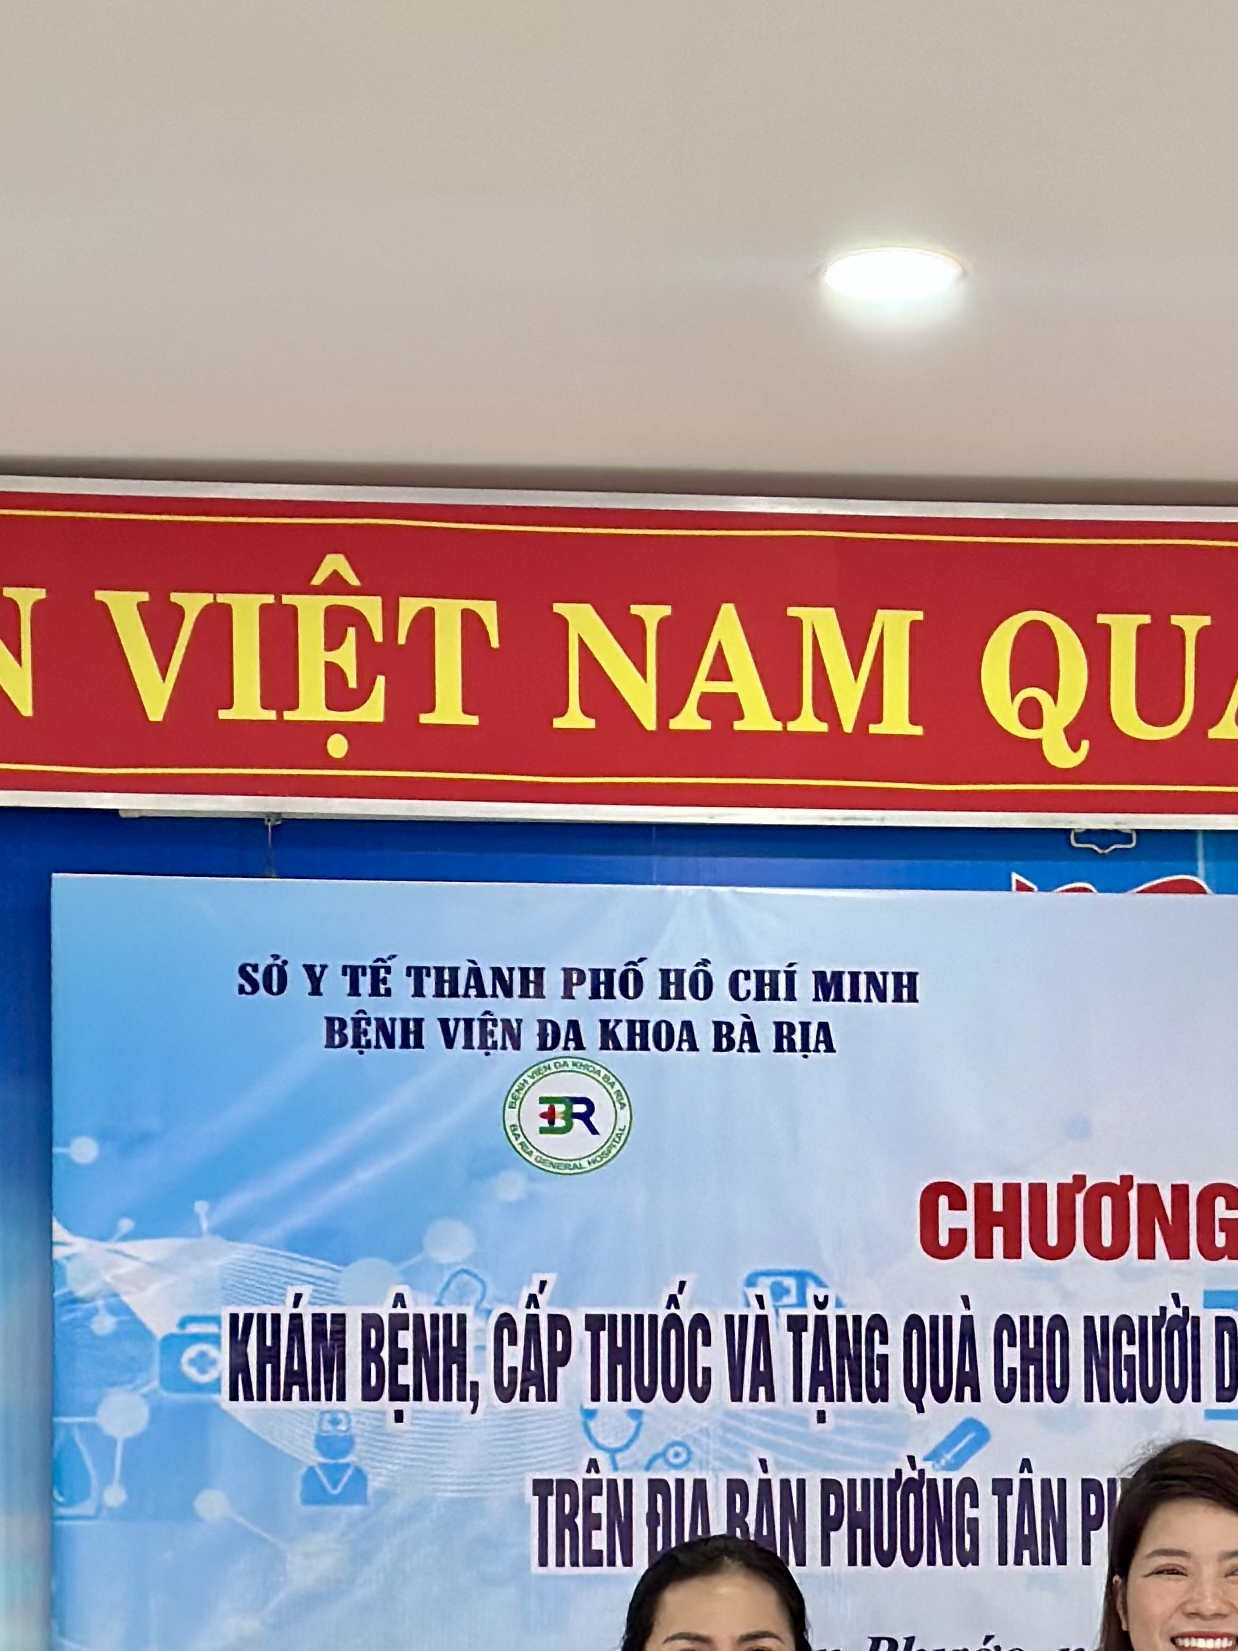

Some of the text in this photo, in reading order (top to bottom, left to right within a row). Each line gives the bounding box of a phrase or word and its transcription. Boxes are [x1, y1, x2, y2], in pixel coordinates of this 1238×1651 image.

[95, 553, 499, 758] VIỆT
[552, 603, 924, 736] NAM
[237, 954, 920, 1004] SỞ Y TẾ THÀNH PHỐ HỒ CHÍ MINH
[324, 1010, 837, 1059] BỆNH VIỆN ĐA KHOA BÀ RỊA
[229, 1293, 346, 1402] KHÁM
[362, 1292, 480, 1423] BỆNH,
[493, 1278, 572, 1404] CẤP
[584, 1281, 712, 1404] THUỐC
[725, 1294, 776, 1403] VÀ
[786, 1294, 890, 1424] TẶNG
[902, 1294, 980, 1414] QUÀ
[993, 1314, 1070, 1404] CHO
[1083, 1292, 1200, 1404] NGƯỜI
[532, 1458, 633, 1567] TRÊN
[821, 1457, 979, 1567] PHƯỜNG
[992, 1457, 1067, 1566] TÂN
